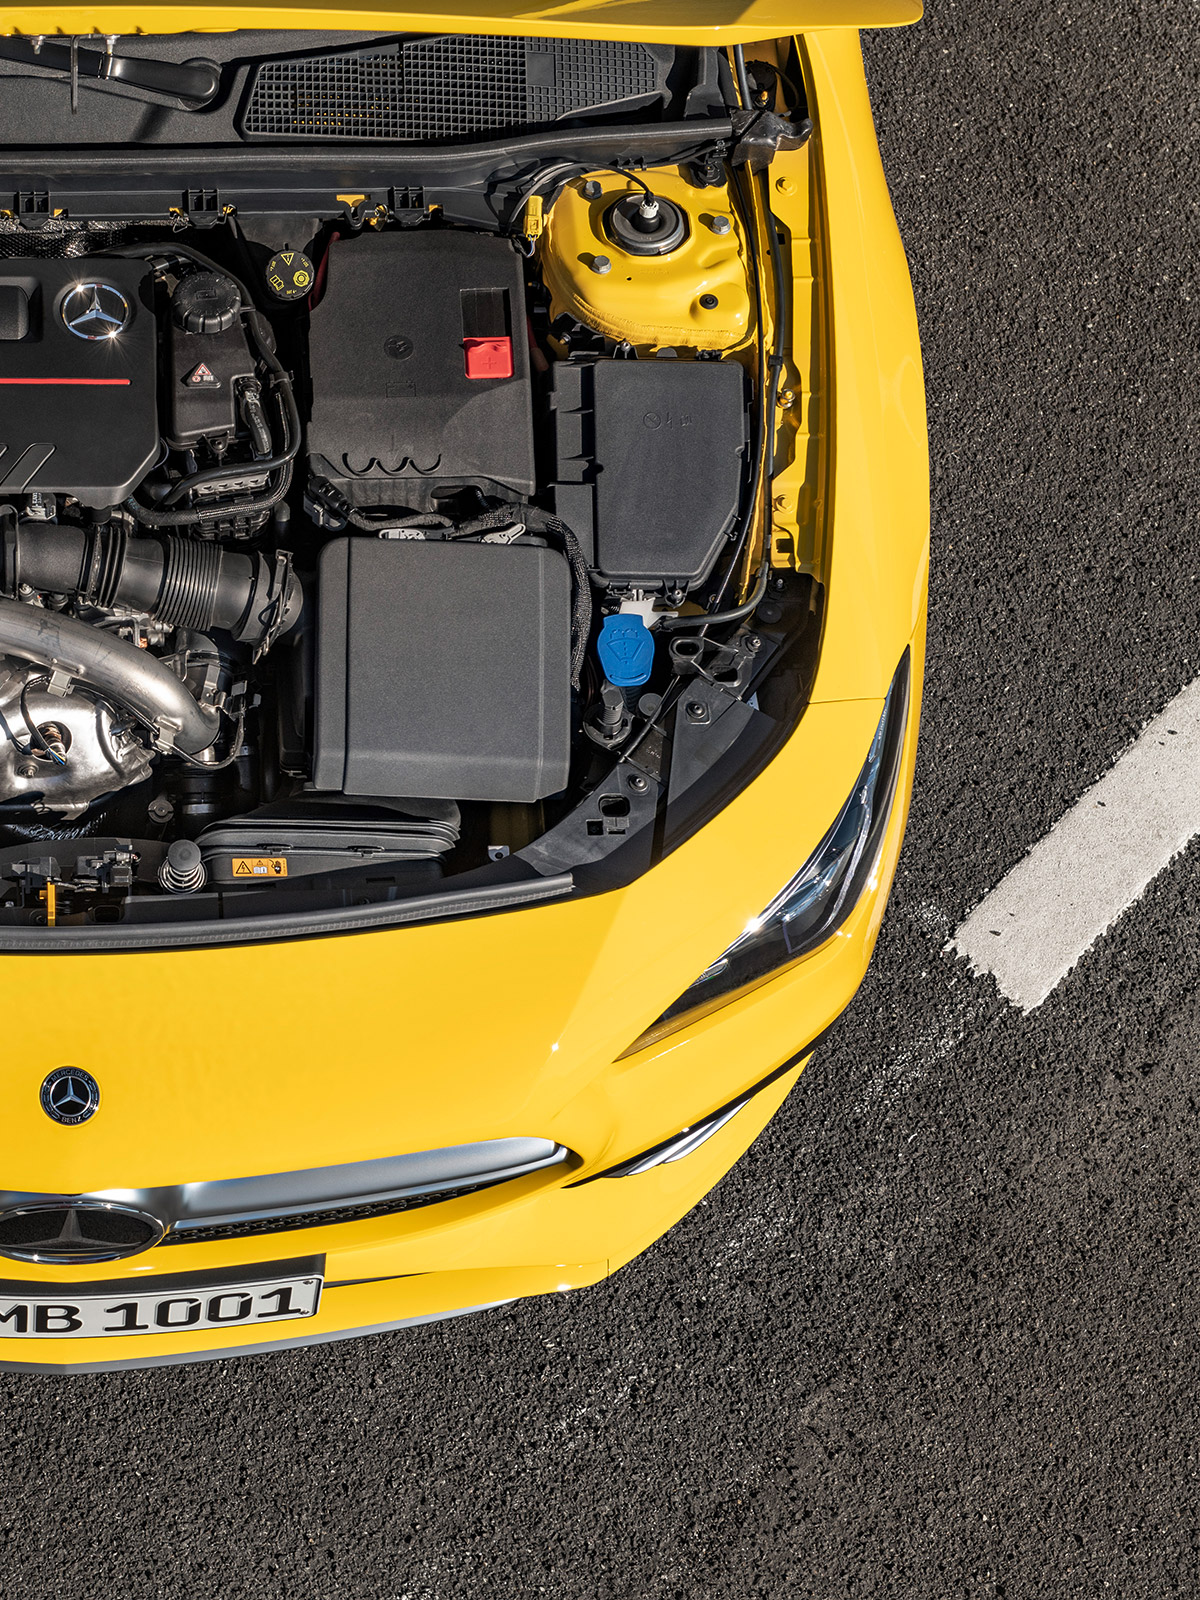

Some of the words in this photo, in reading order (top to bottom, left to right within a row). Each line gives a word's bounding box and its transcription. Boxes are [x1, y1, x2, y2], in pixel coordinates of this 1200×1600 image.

[50, 1069, 90, 1082] MERCEDES
[60, 1116, 83, 1124] BENZ
[104, 1287, 302, 1331] 1001
